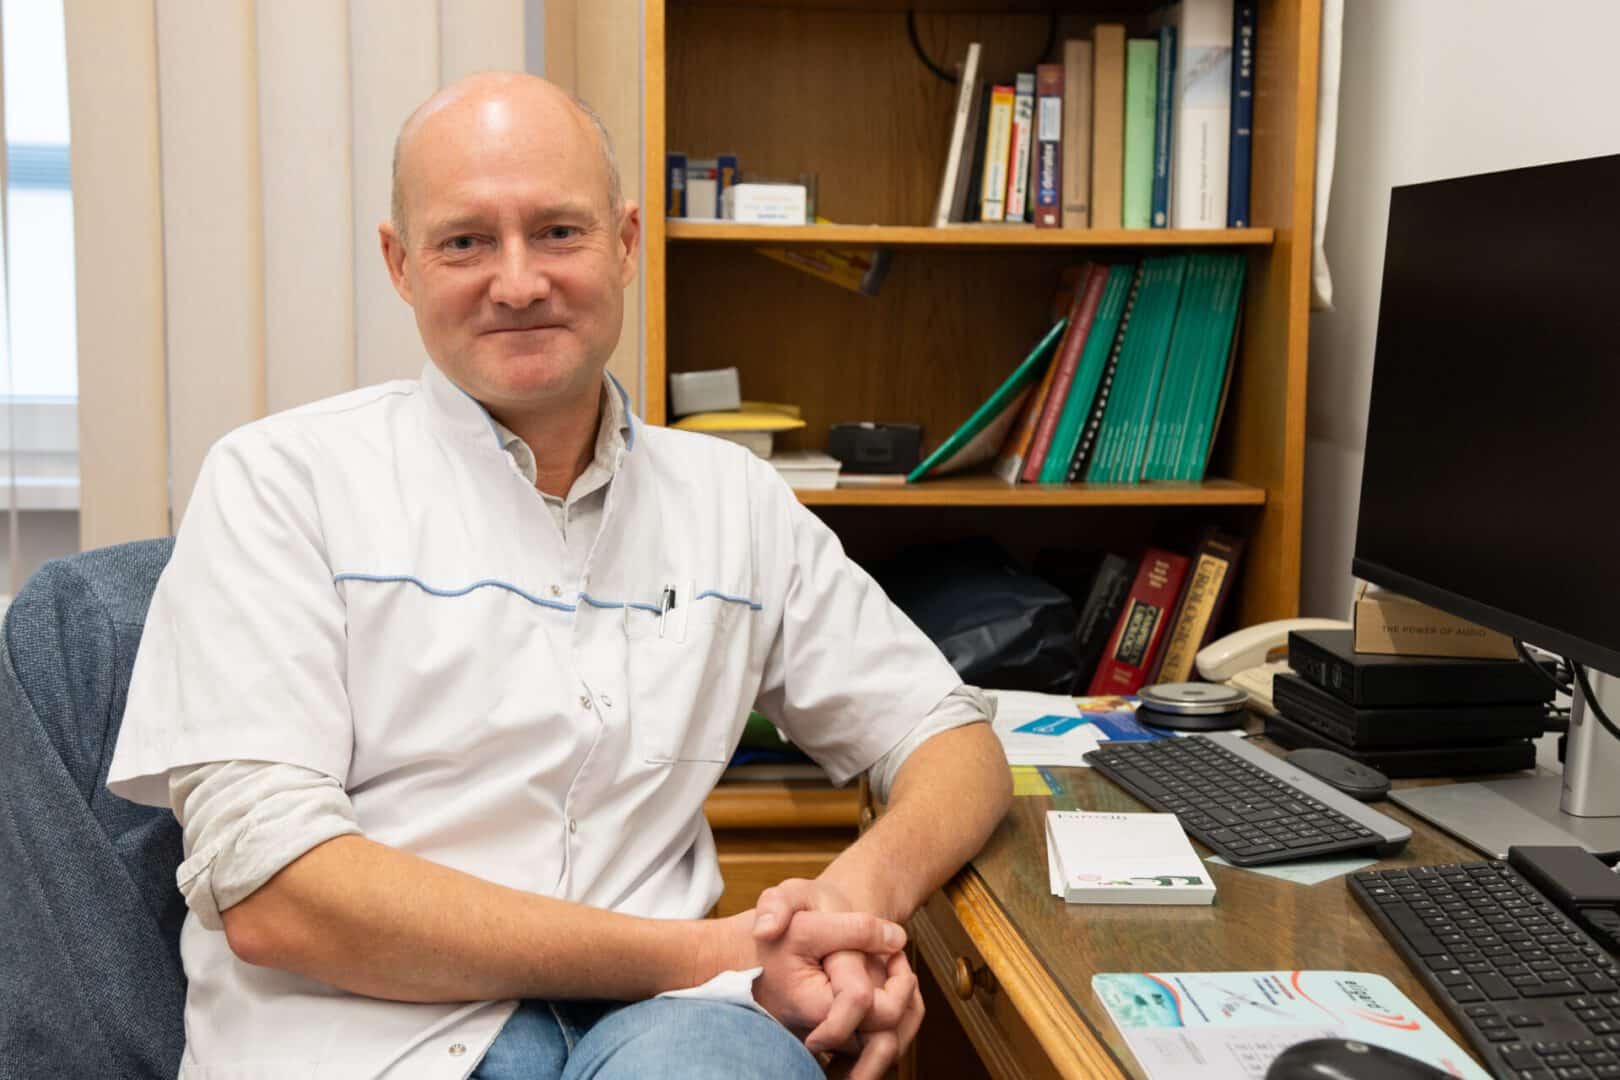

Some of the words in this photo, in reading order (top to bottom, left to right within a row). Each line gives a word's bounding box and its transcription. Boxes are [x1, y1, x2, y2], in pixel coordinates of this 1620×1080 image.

[1119, 605, 1146, 657] UROLOGY
[1383, 626, 1399, 634] THE
[1402, 626, 1437, 635] POWER
[1440, 627, 1454, 636] OF
